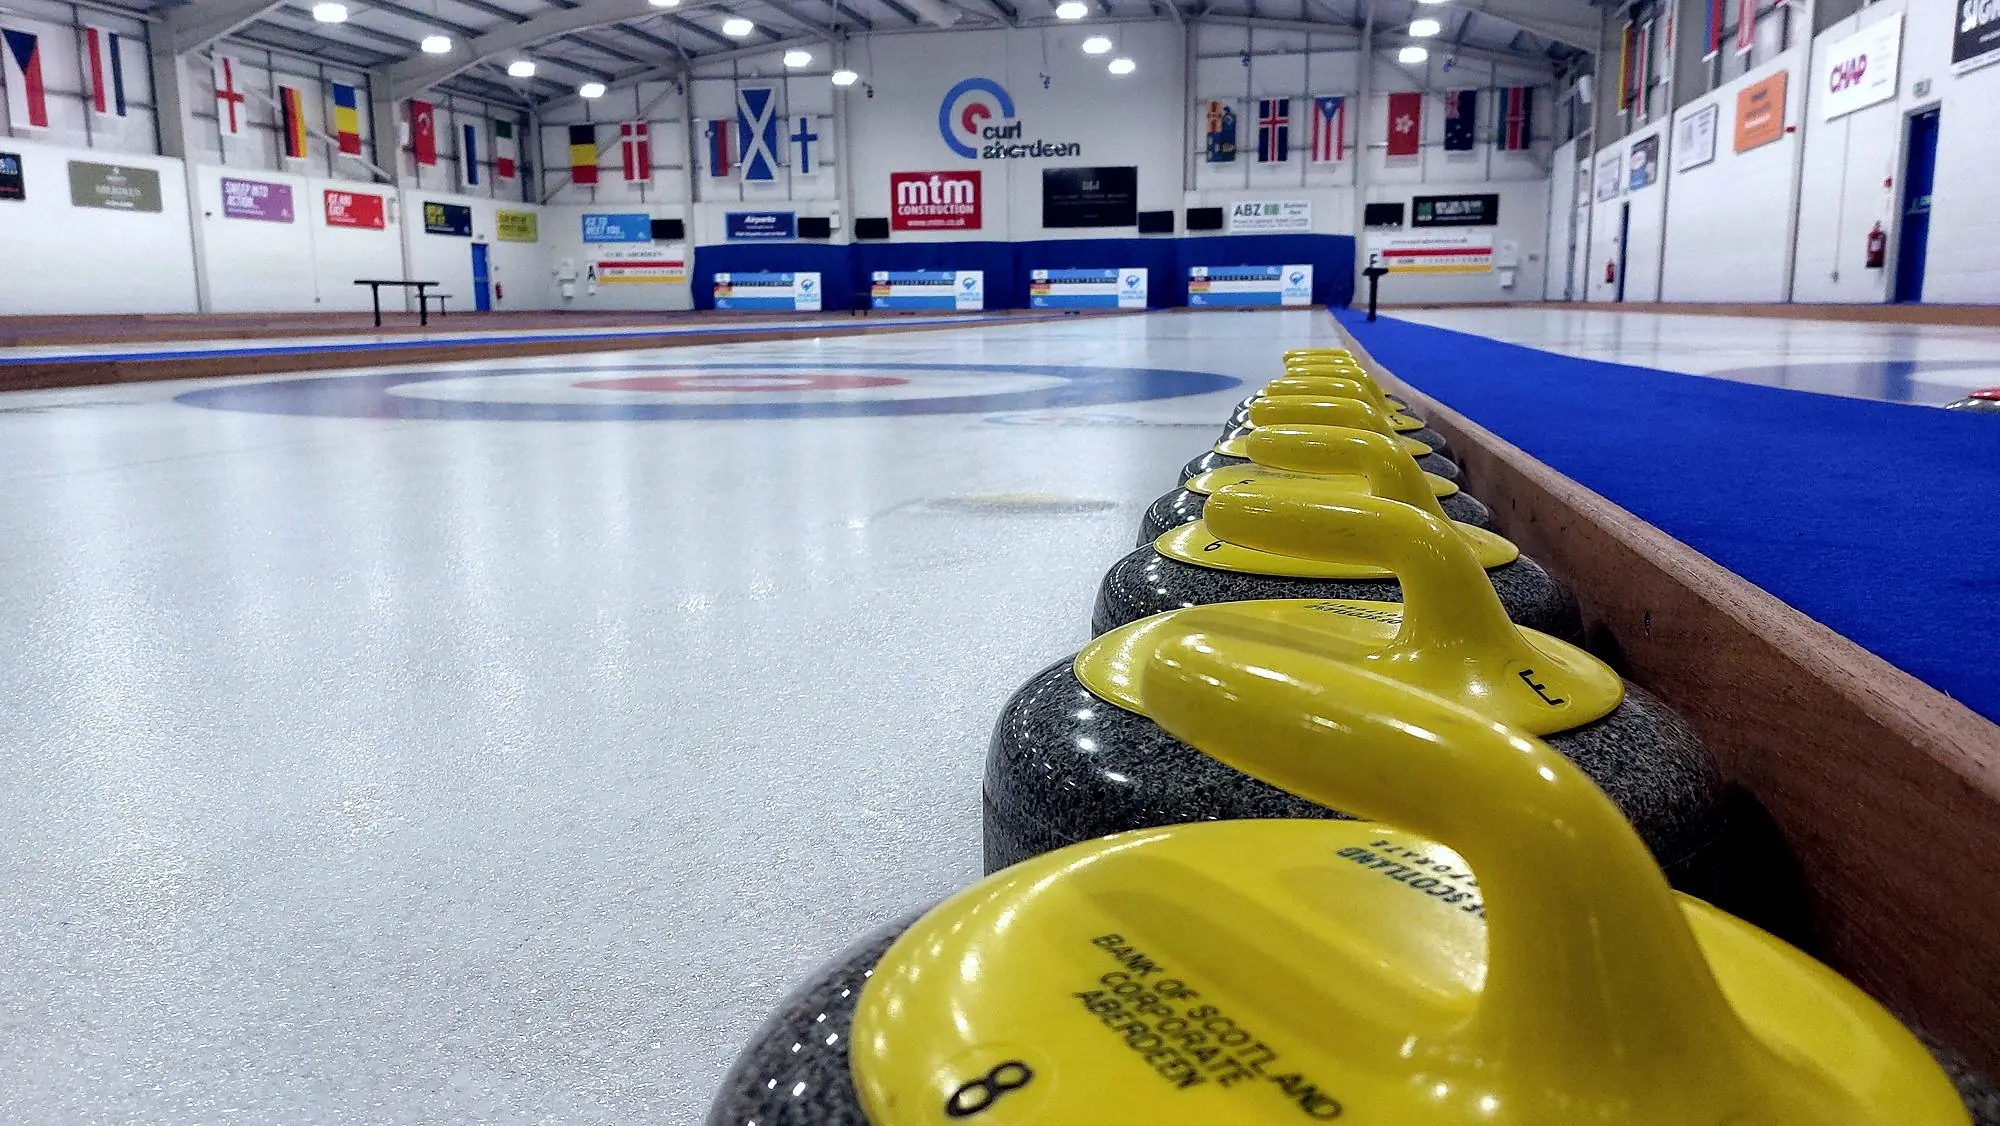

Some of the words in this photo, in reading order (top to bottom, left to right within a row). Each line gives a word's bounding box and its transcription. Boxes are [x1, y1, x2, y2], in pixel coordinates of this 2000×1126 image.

[983, 120, 1022, 140] curl
[983, 139, 1081, 159] aberdeen
[898, 175, 975, 205] mtm
[898, 204, 974, 216] CONSTRUCTION
[1233, 203, 1262, 217] ABZ
[1072, 990, 1207, 1091] ABERDEEN
[1090, 933, 1164, 978] BANK
[1152, 978, 1201, 1001] OF
[1186, 1003, 1343, 1121] SCOTLAND
[1099, 970, 1255, 1088] CORPORATE
[944, 1060, 1034, 1119] 8
